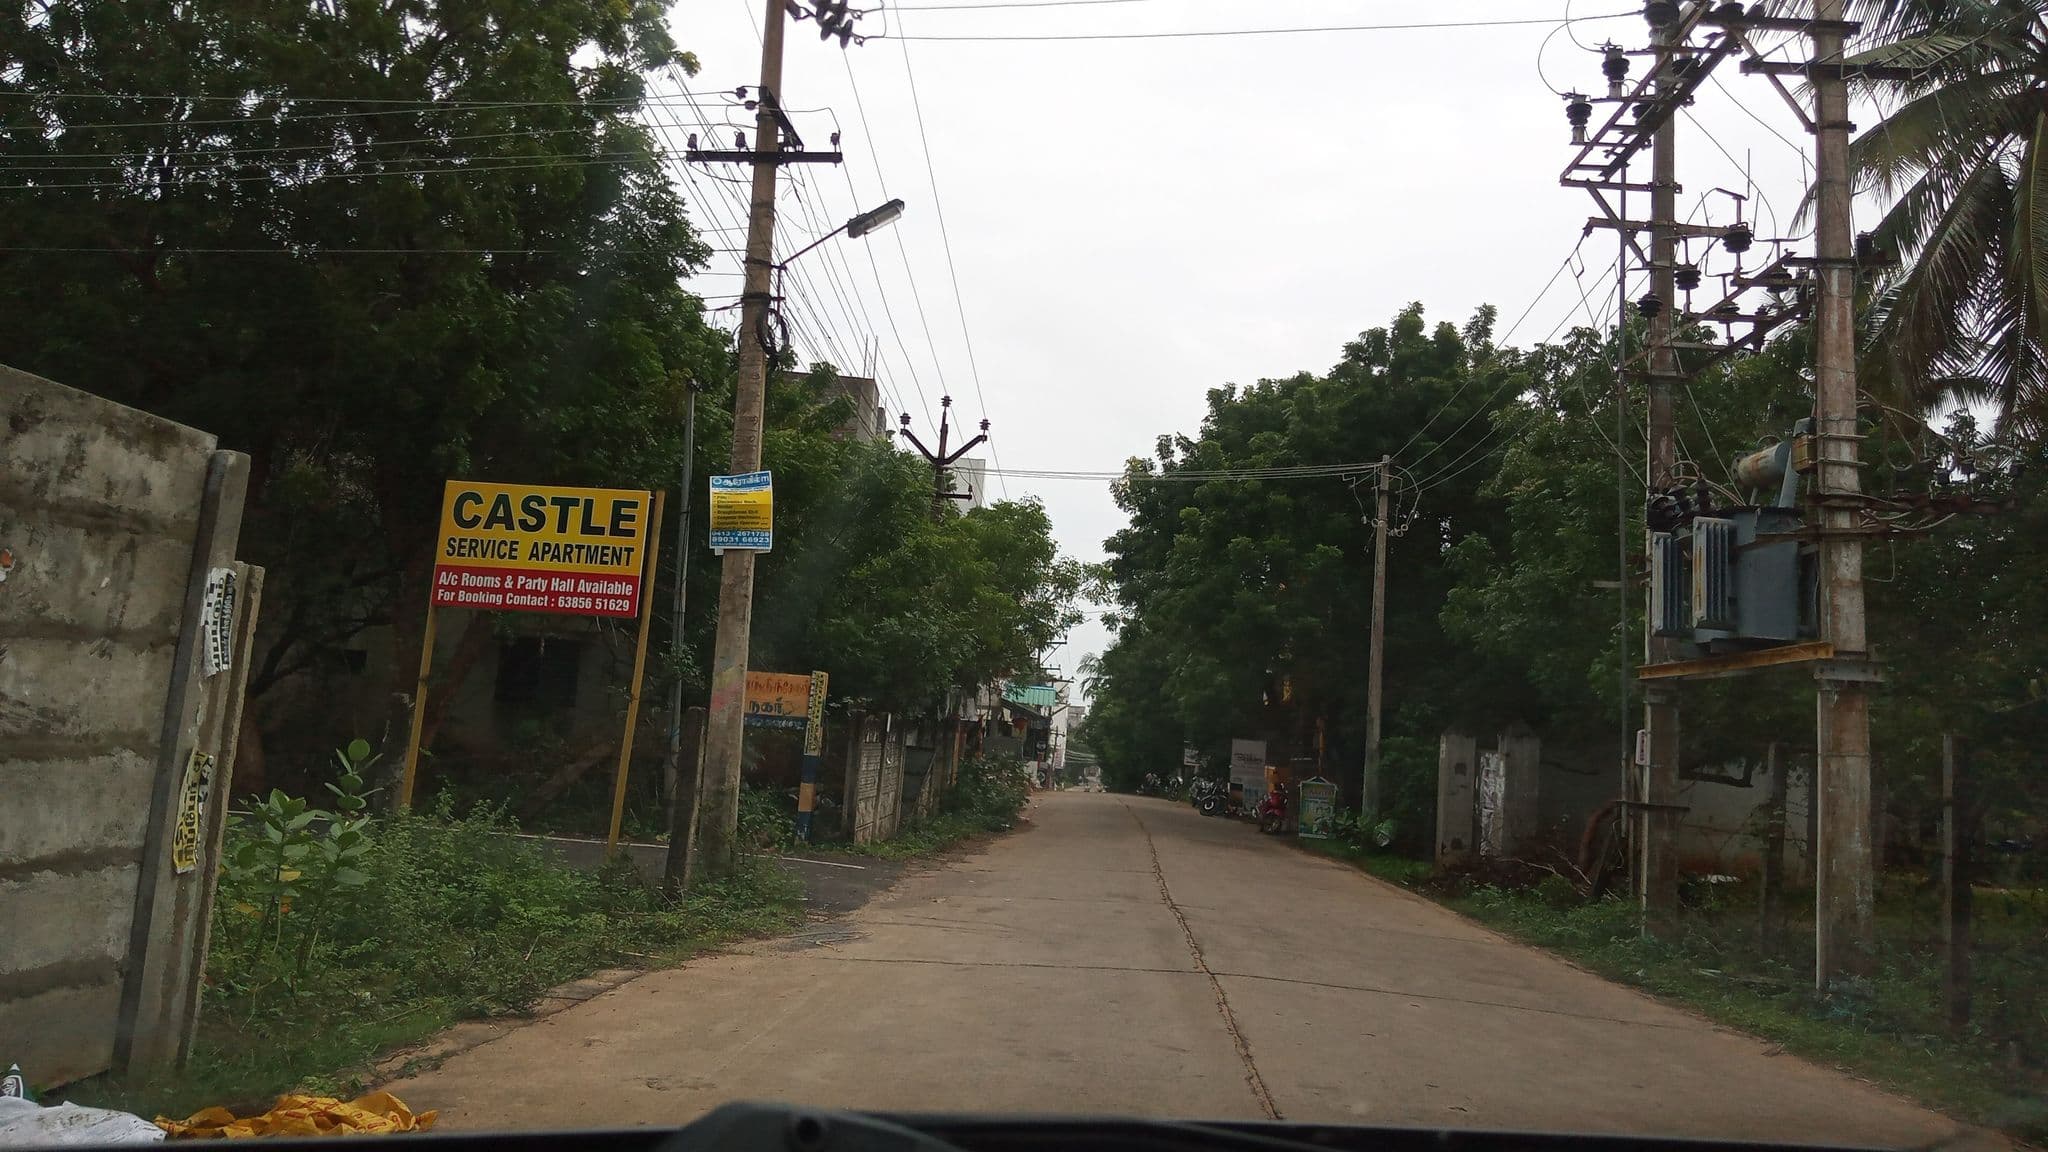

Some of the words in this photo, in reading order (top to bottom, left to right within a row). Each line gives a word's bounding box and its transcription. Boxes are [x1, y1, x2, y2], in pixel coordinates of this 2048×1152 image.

[453, 491, 639, 537] CASTLE
[446, 537, 519, 560] SERVICE
[528, 541, 634, 566] APARTMENT
[438, 571, 458, 586] A/c
[461, 572, 501, 589] Rooms
[504, 575, 514, 589] &
[517, 576, 548, 592] Party
[551, 578, 574, 592] Hall
[577, 578, 632, 596] Available
[438, 588, 456, 601] For
[458, 590, 502, 605] Booking
[506, 593, 548, 607] Contact
[558, 596, 592, 610] 63856
[594, 598, 630, 612] 51629
